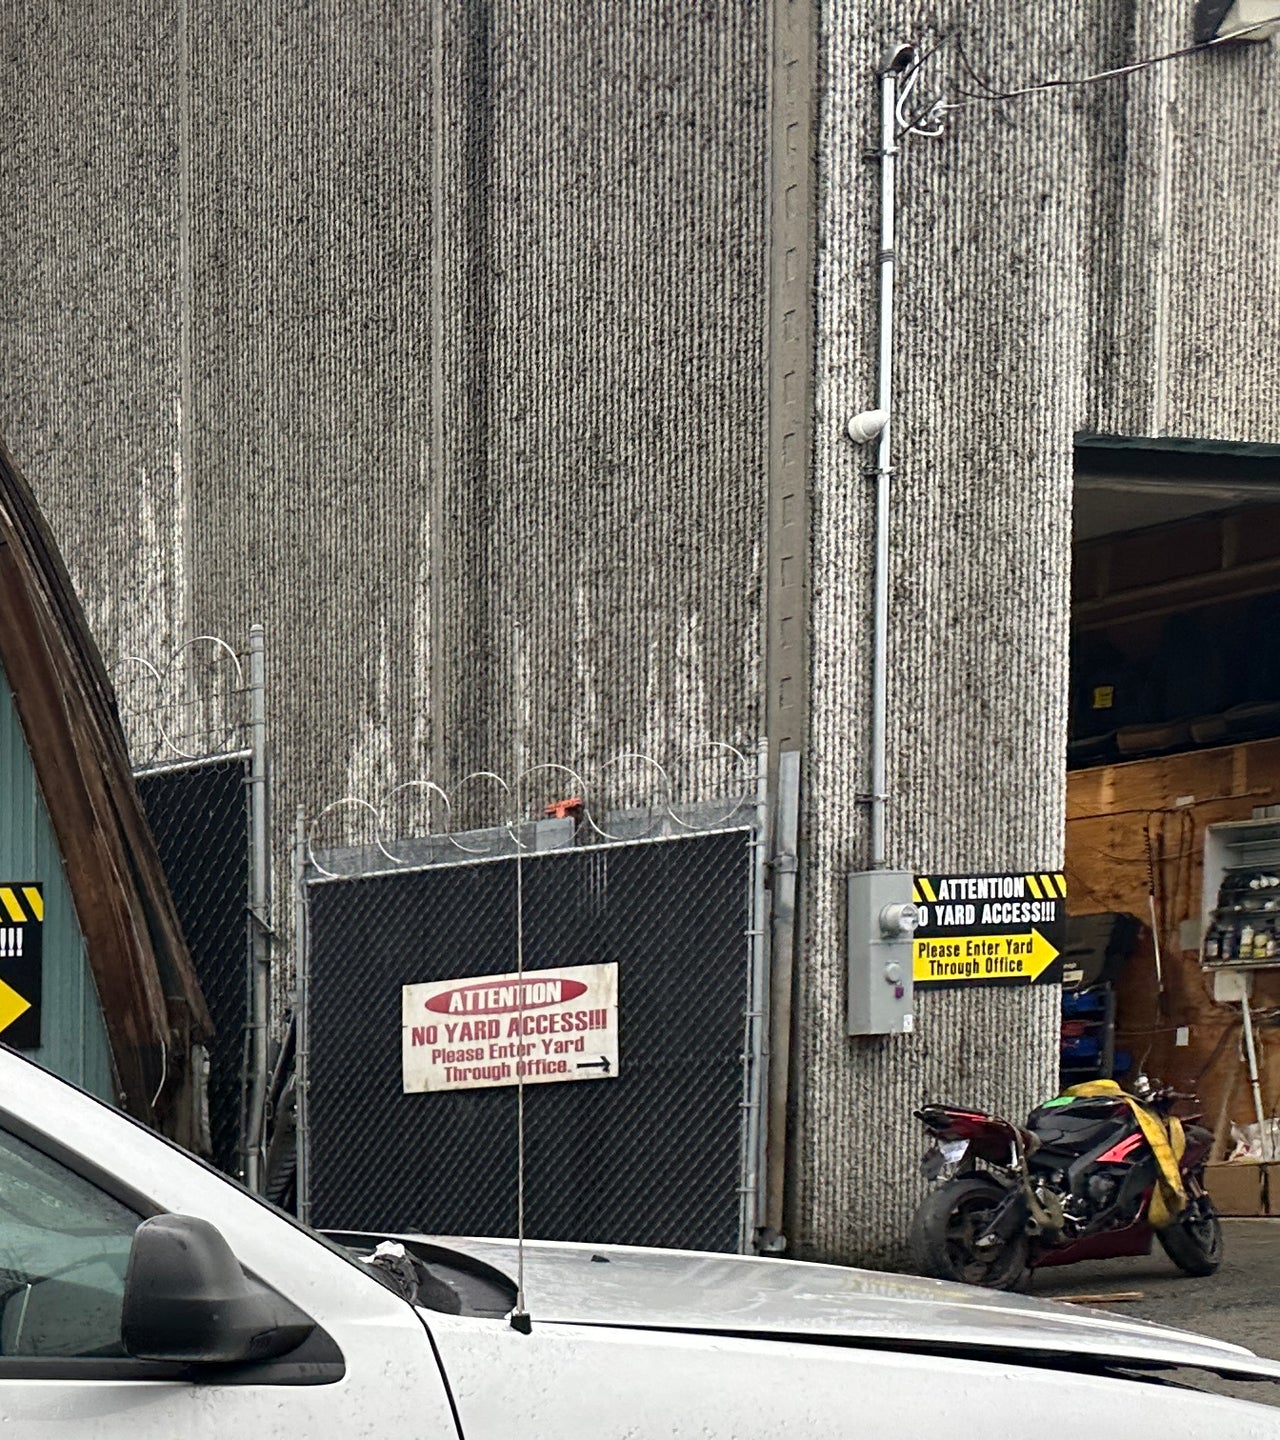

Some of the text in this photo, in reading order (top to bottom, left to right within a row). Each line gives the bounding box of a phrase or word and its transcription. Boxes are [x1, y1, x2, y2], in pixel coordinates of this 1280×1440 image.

[939, 876, 1025, 900] ATTENTION
[935, 904, 975, 926] YARD
[981, 901, 1056, 924] ACCESS!!!
[919, 938, 1033, 959] Please Enter Yard
[929, 958, 1023, 976] Through Office
[448, 981, 562, 1012] ATTENTION
[412, 1009, 608, 1046] NO YARD ACCESS!!!
[431, 1036, 585, 1064] Please Enter Yard
[444, 1062, 511, 1082] Through
